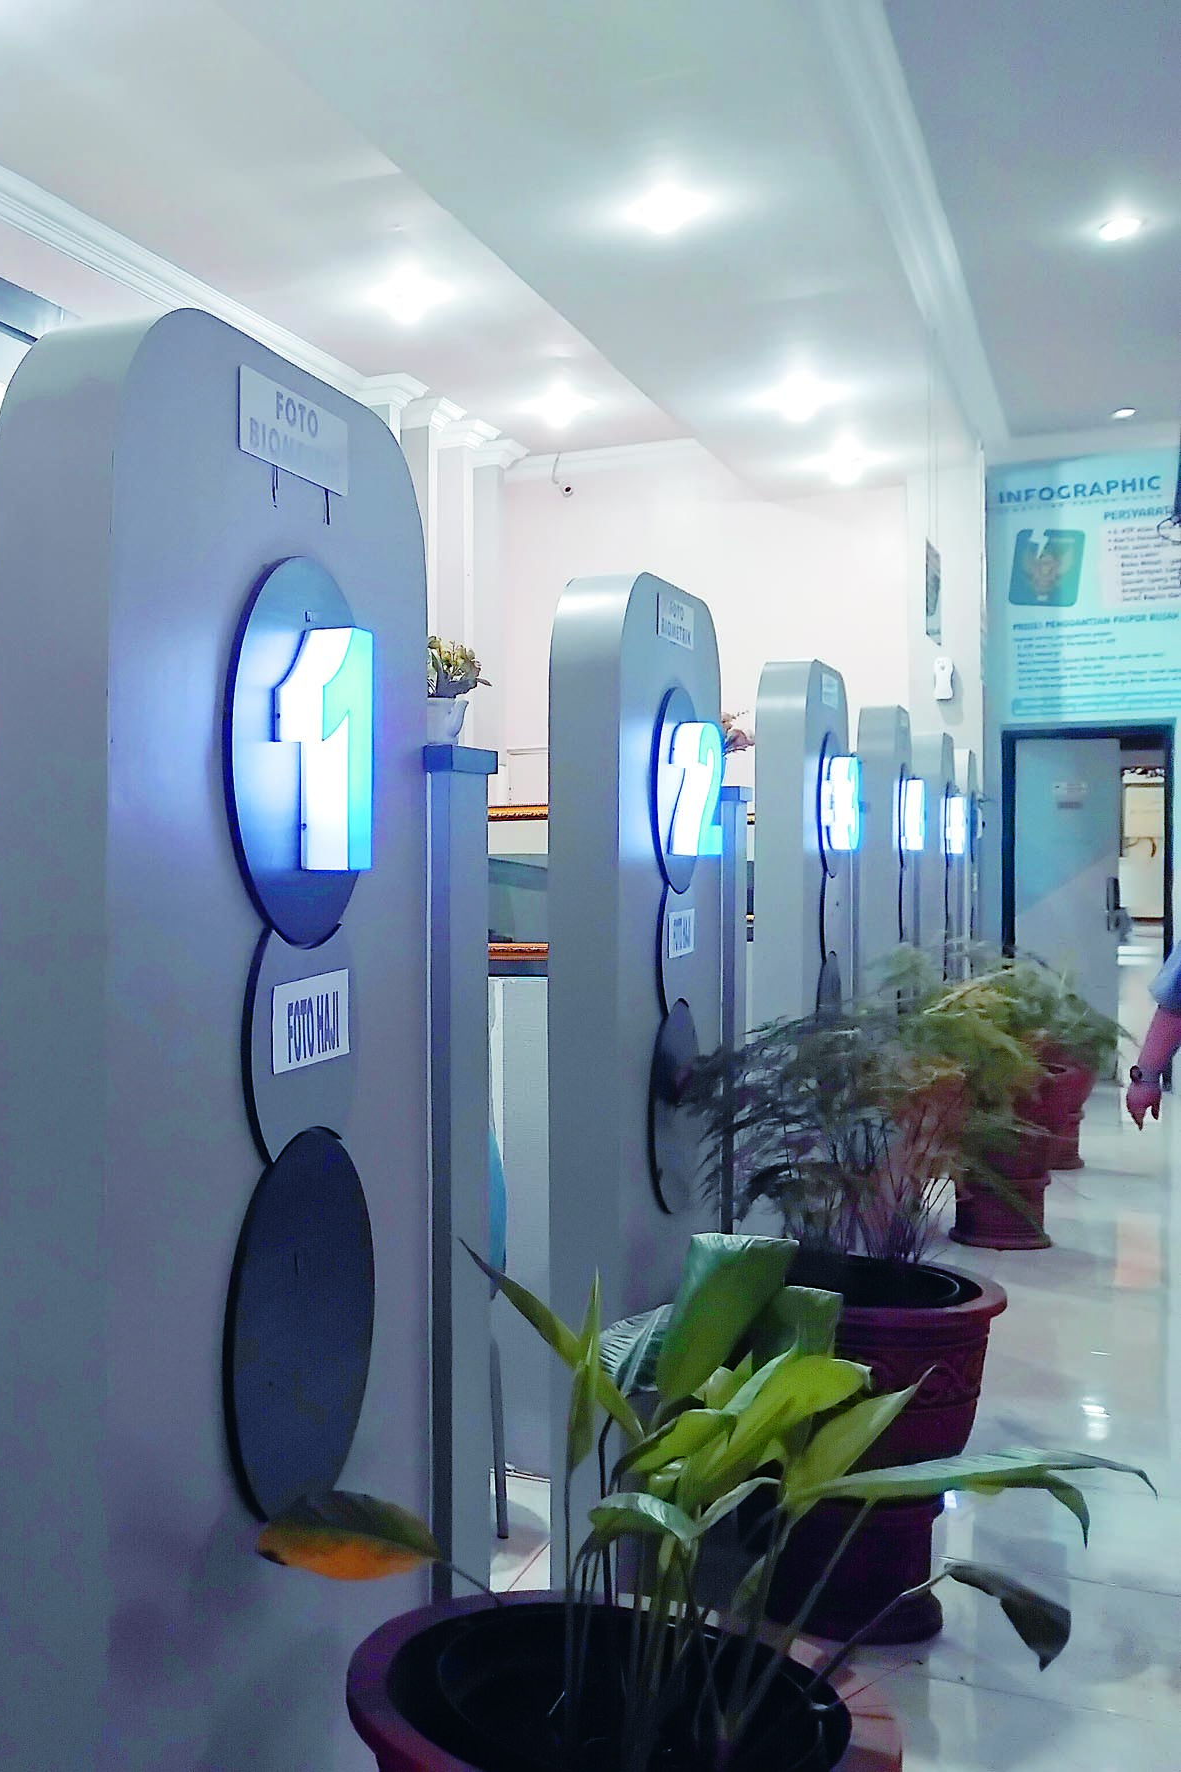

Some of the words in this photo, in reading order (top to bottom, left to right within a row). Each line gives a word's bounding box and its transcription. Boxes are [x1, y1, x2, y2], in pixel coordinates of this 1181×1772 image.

[275, 391, 318, 438] FOTO
[999, 475, 1162, 504] INFOGRAPHIC
[274, 626, 373, 870] 1
[668, 721, 723, 857] 2
[287, 996, 314, 1064] FOTO
[316, 991, 339, 1054] HAJI
